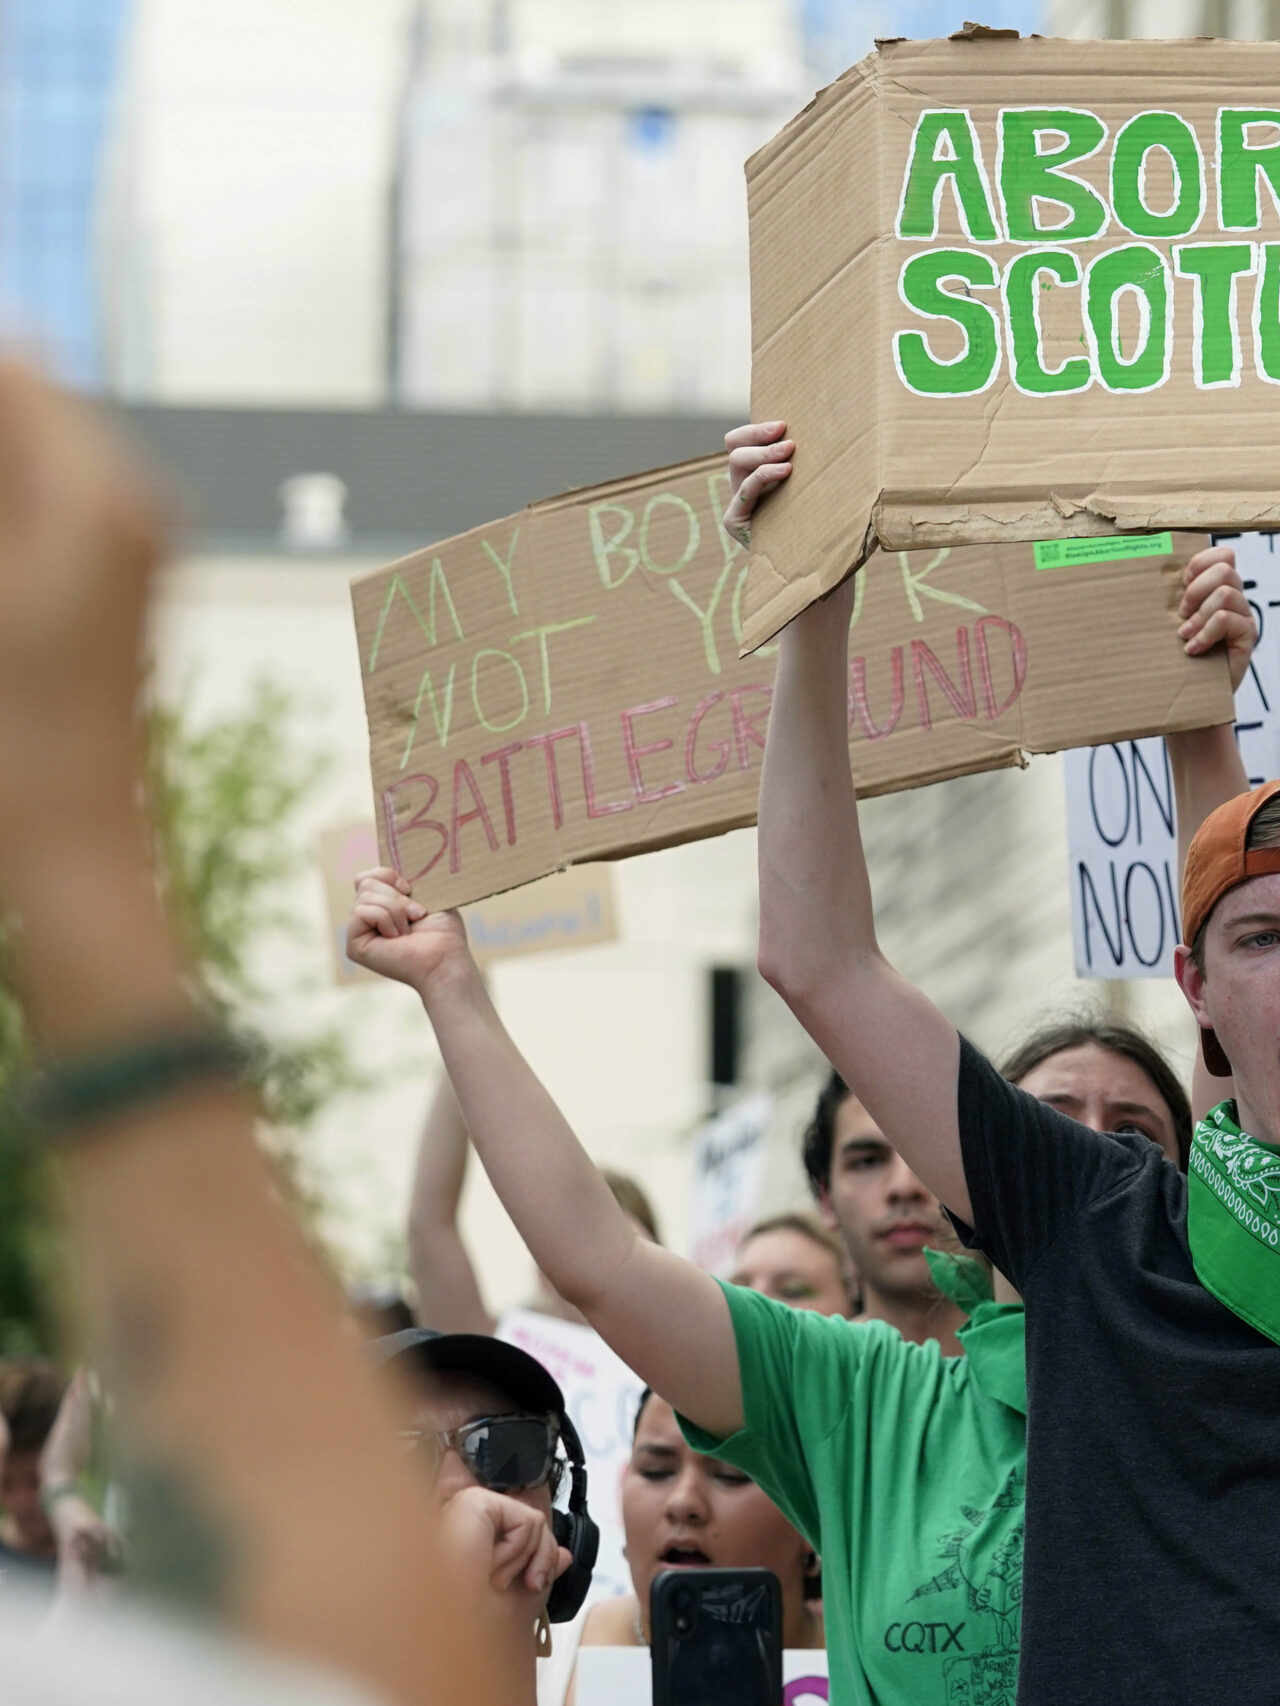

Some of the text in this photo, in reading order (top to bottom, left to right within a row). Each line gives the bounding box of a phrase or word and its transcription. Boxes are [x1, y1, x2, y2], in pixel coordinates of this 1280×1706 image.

[368, 527, 520, 673] MY
[382, 614, 1028, 881] BATTLEGRUND
[401, 614, 597, 771] NOT
[1089, 740, 1176, 849] ON
[1079, 861, 1181, 969] NO
[884, 1621, 966, 1653] CQTX
